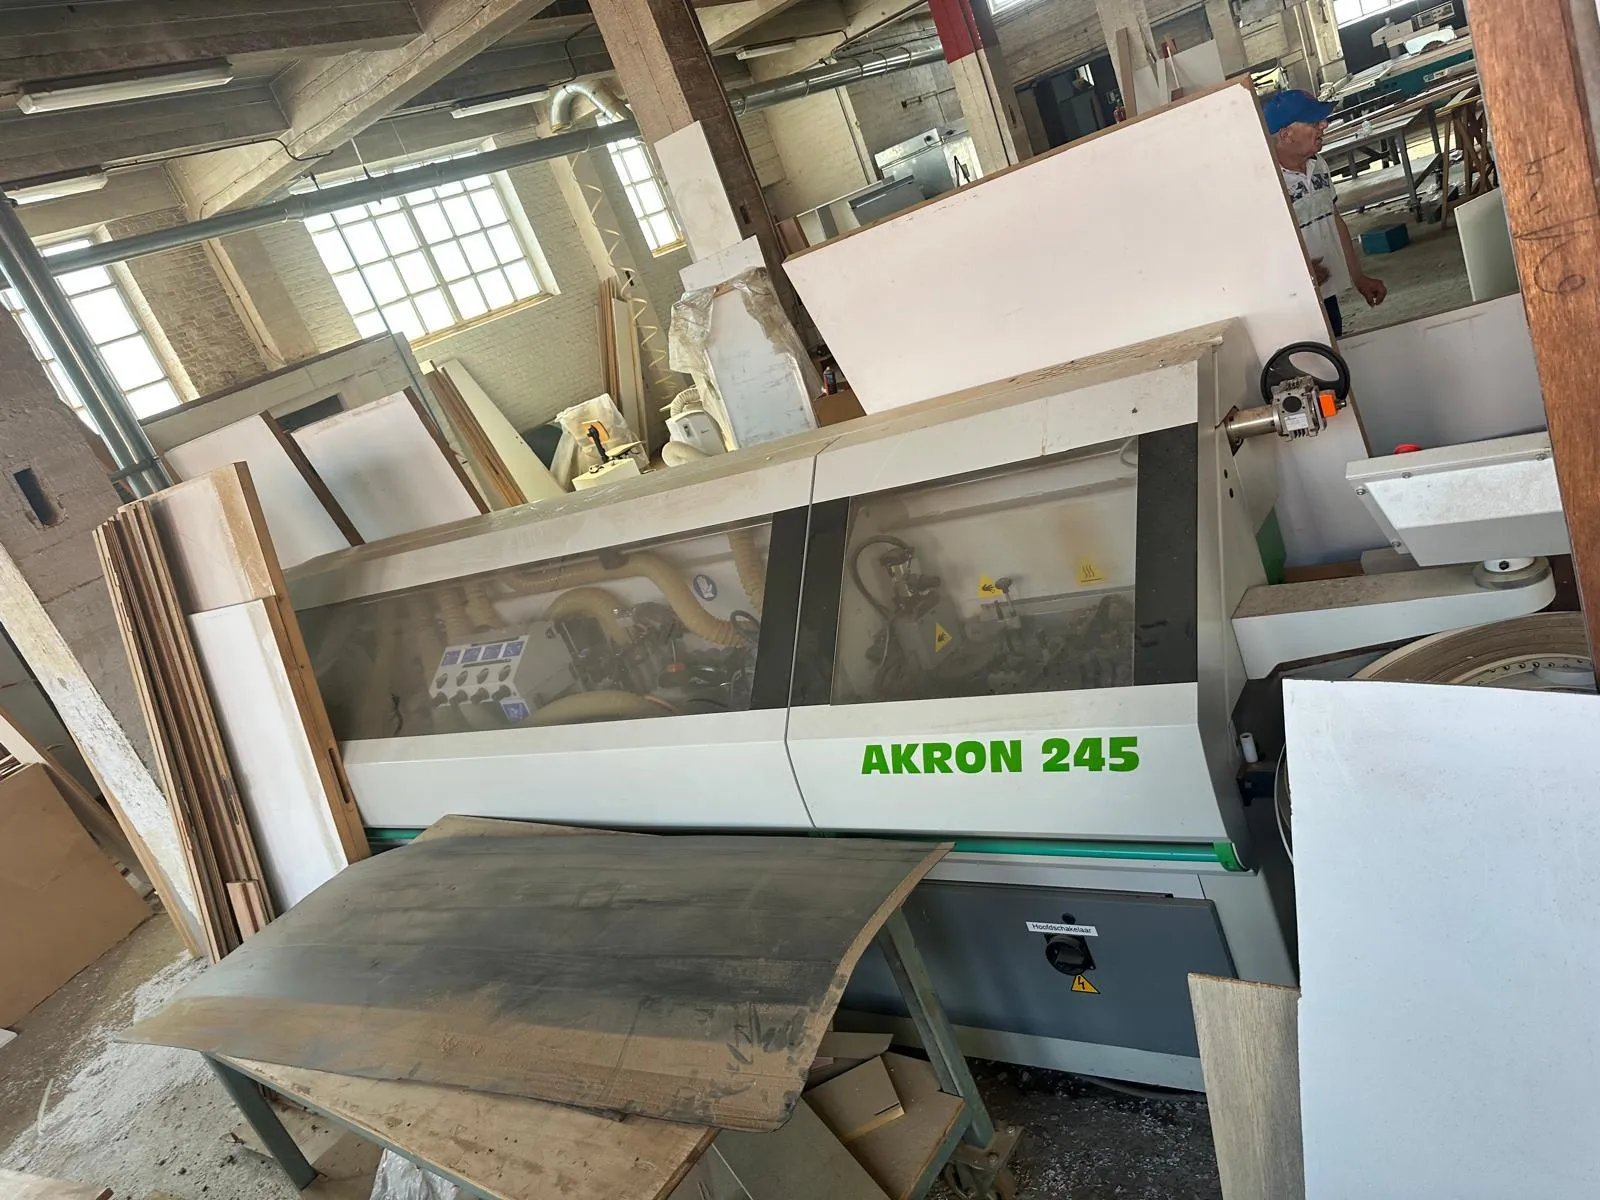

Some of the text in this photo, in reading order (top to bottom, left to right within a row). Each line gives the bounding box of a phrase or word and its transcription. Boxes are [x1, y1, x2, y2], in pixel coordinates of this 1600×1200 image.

[861, 735, 1140, 775] AKRON 245
[1031, 923, 1092, 934] Hoofdschakelaar
